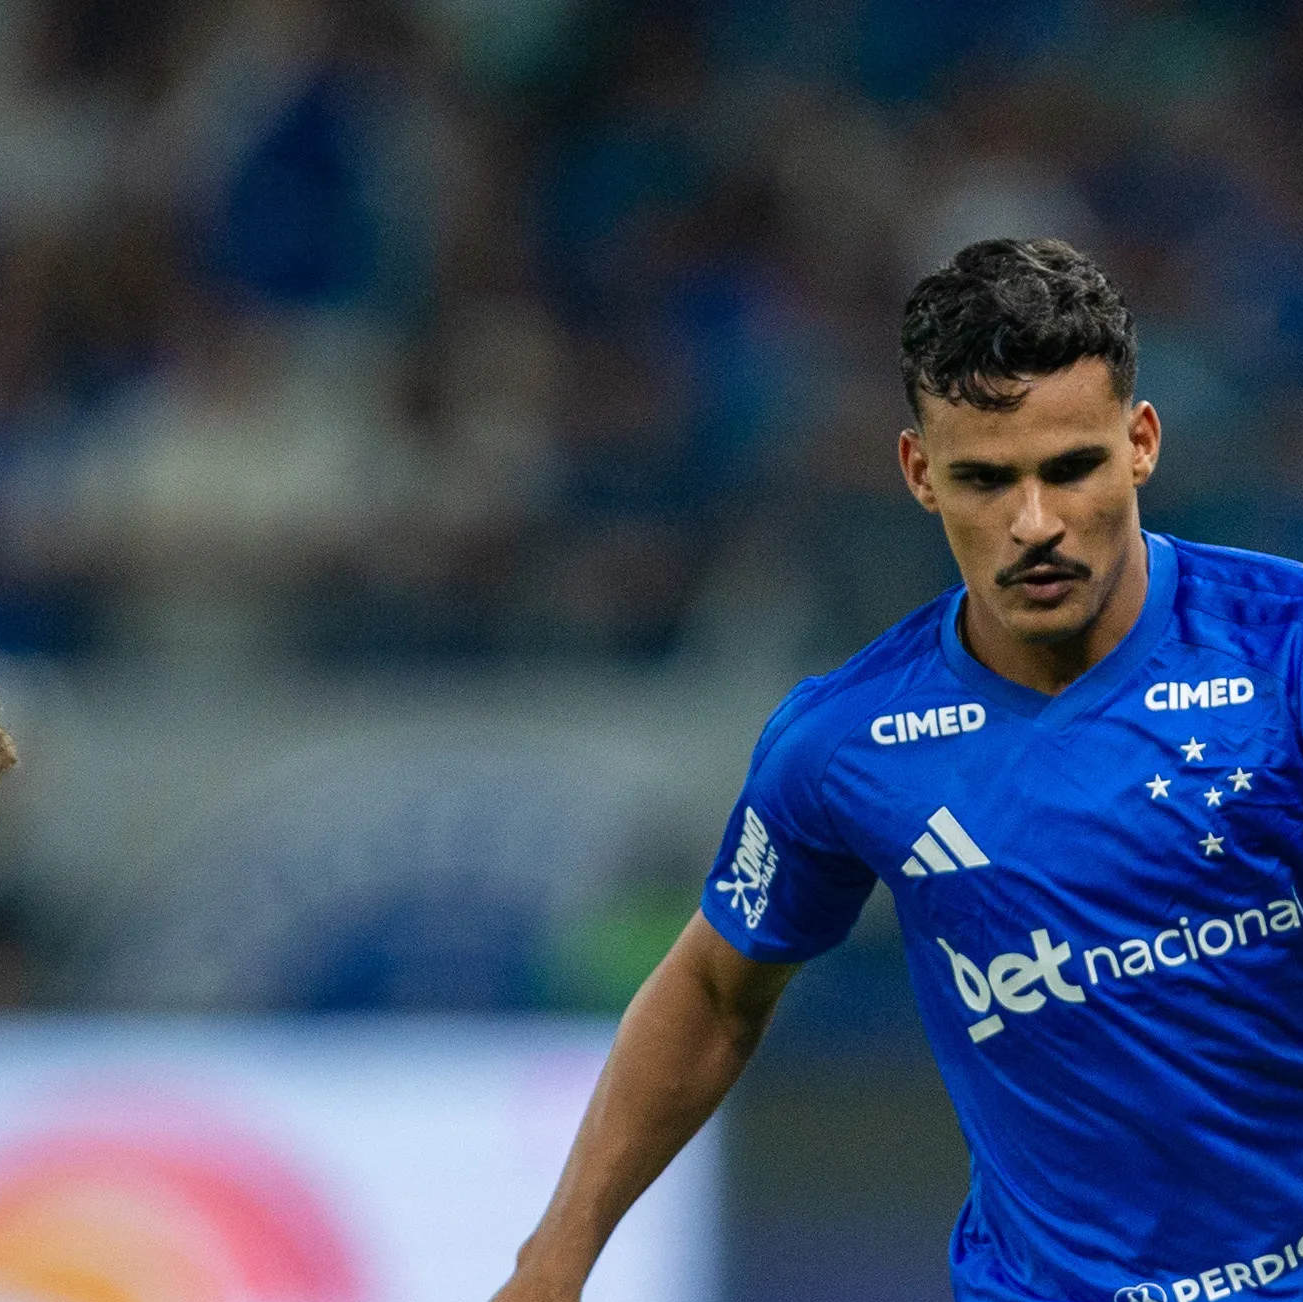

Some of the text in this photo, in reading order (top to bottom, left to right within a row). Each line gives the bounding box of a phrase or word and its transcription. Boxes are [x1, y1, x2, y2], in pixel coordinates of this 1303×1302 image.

[1144, 677, 1255, 712] CIMED
[870, 702, 987, 746] CIMED
[936, 927, 1087, 1014] bet
